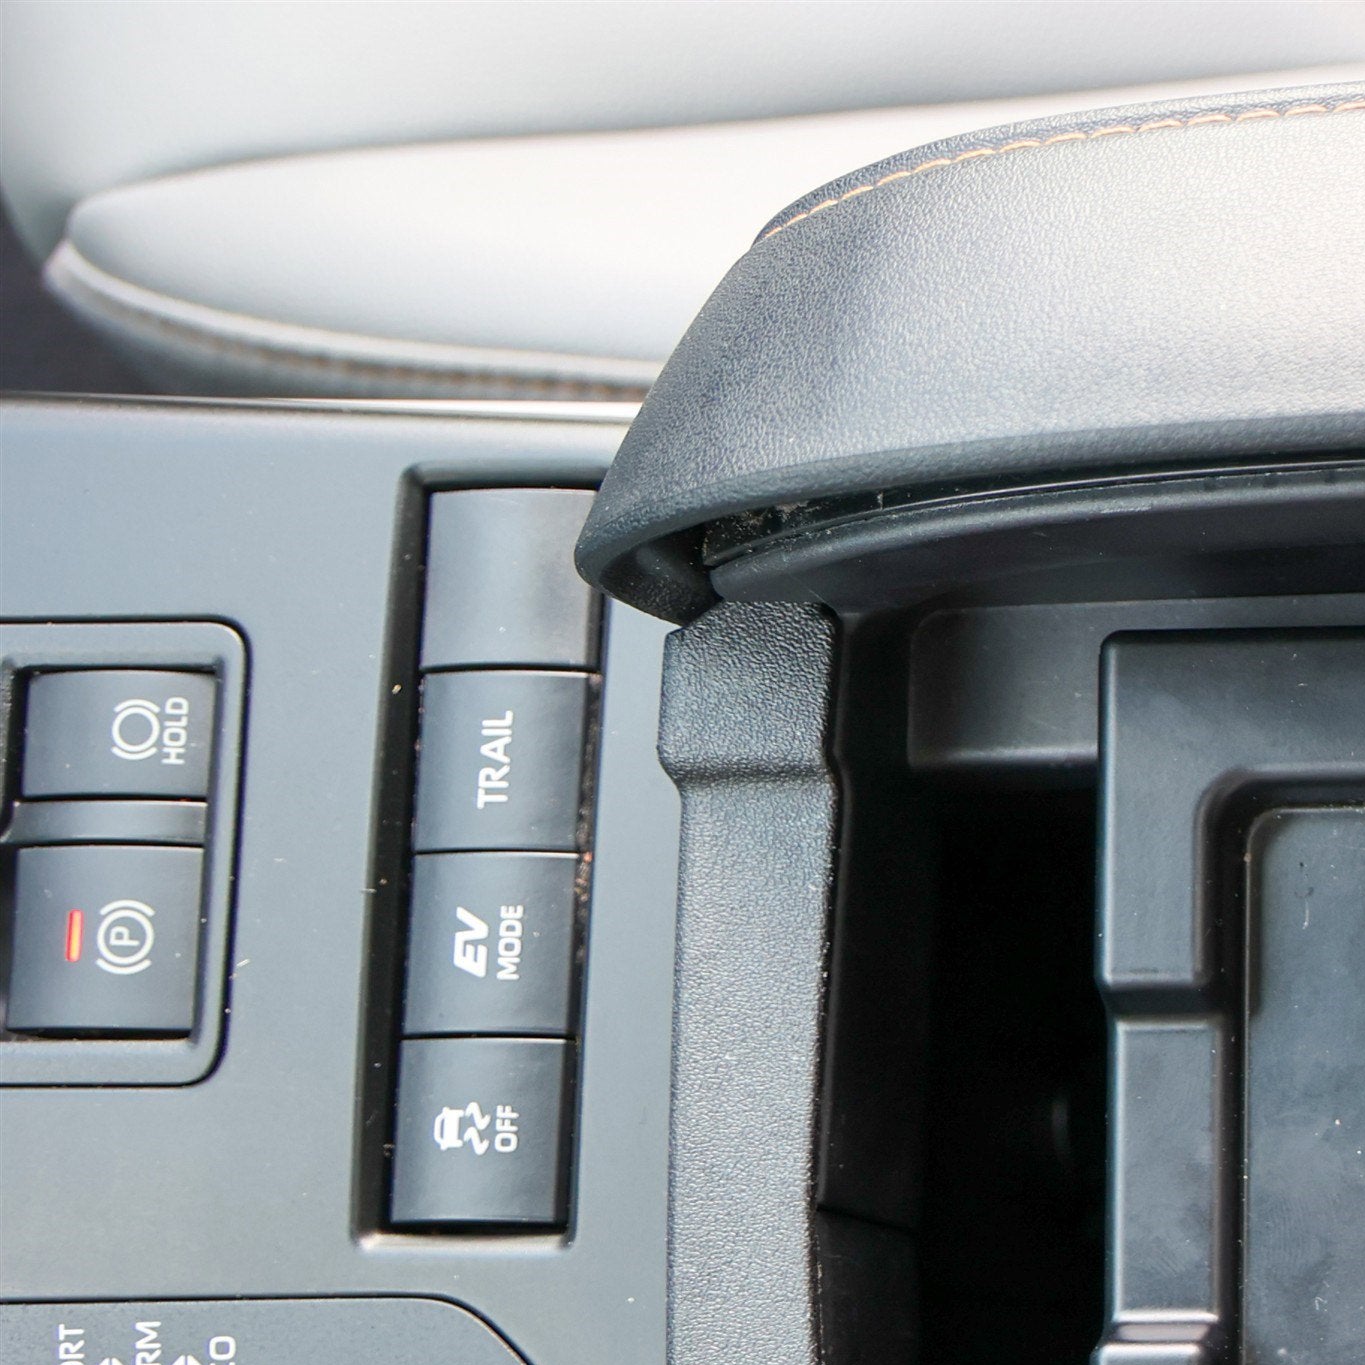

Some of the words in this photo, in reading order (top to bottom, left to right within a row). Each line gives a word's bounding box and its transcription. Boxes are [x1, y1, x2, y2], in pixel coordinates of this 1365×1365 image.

[161, 697, 190, 766] HOLD
[476, 710, 515, 811] TRAIL
[112, 926, 139, 948] P
[453, 906, 490, 979] EV
[496, 905, 525, 981] MODE
[494, 1105, 520, 1154] OFF
